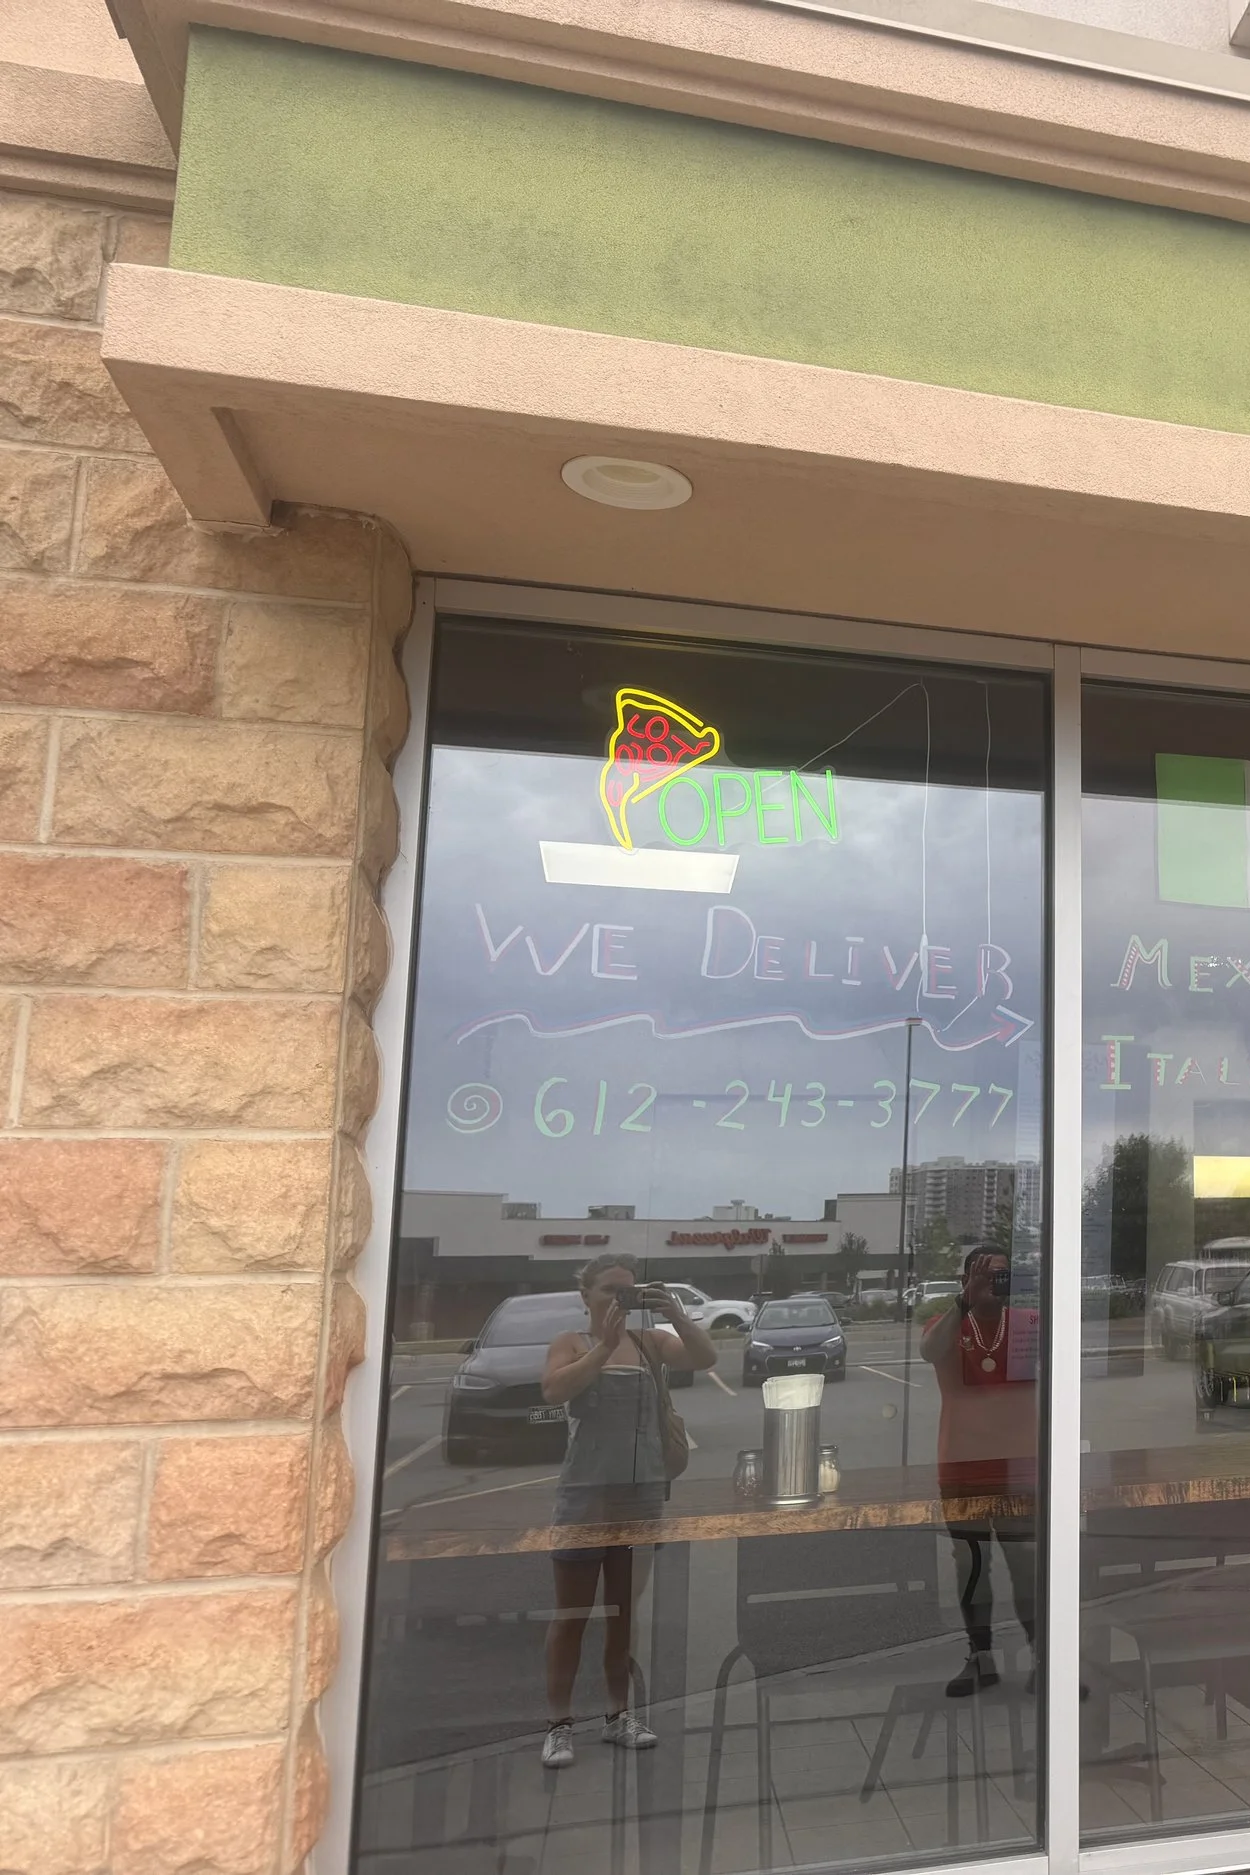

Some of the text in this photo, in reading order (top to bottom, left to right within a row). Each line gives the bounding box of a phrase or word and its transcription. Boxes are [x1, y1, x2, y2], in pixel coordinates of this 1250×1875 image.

[658, 769, 840, 846] OPEN
[474, 902, 1014, 1000] WE DELIVER
